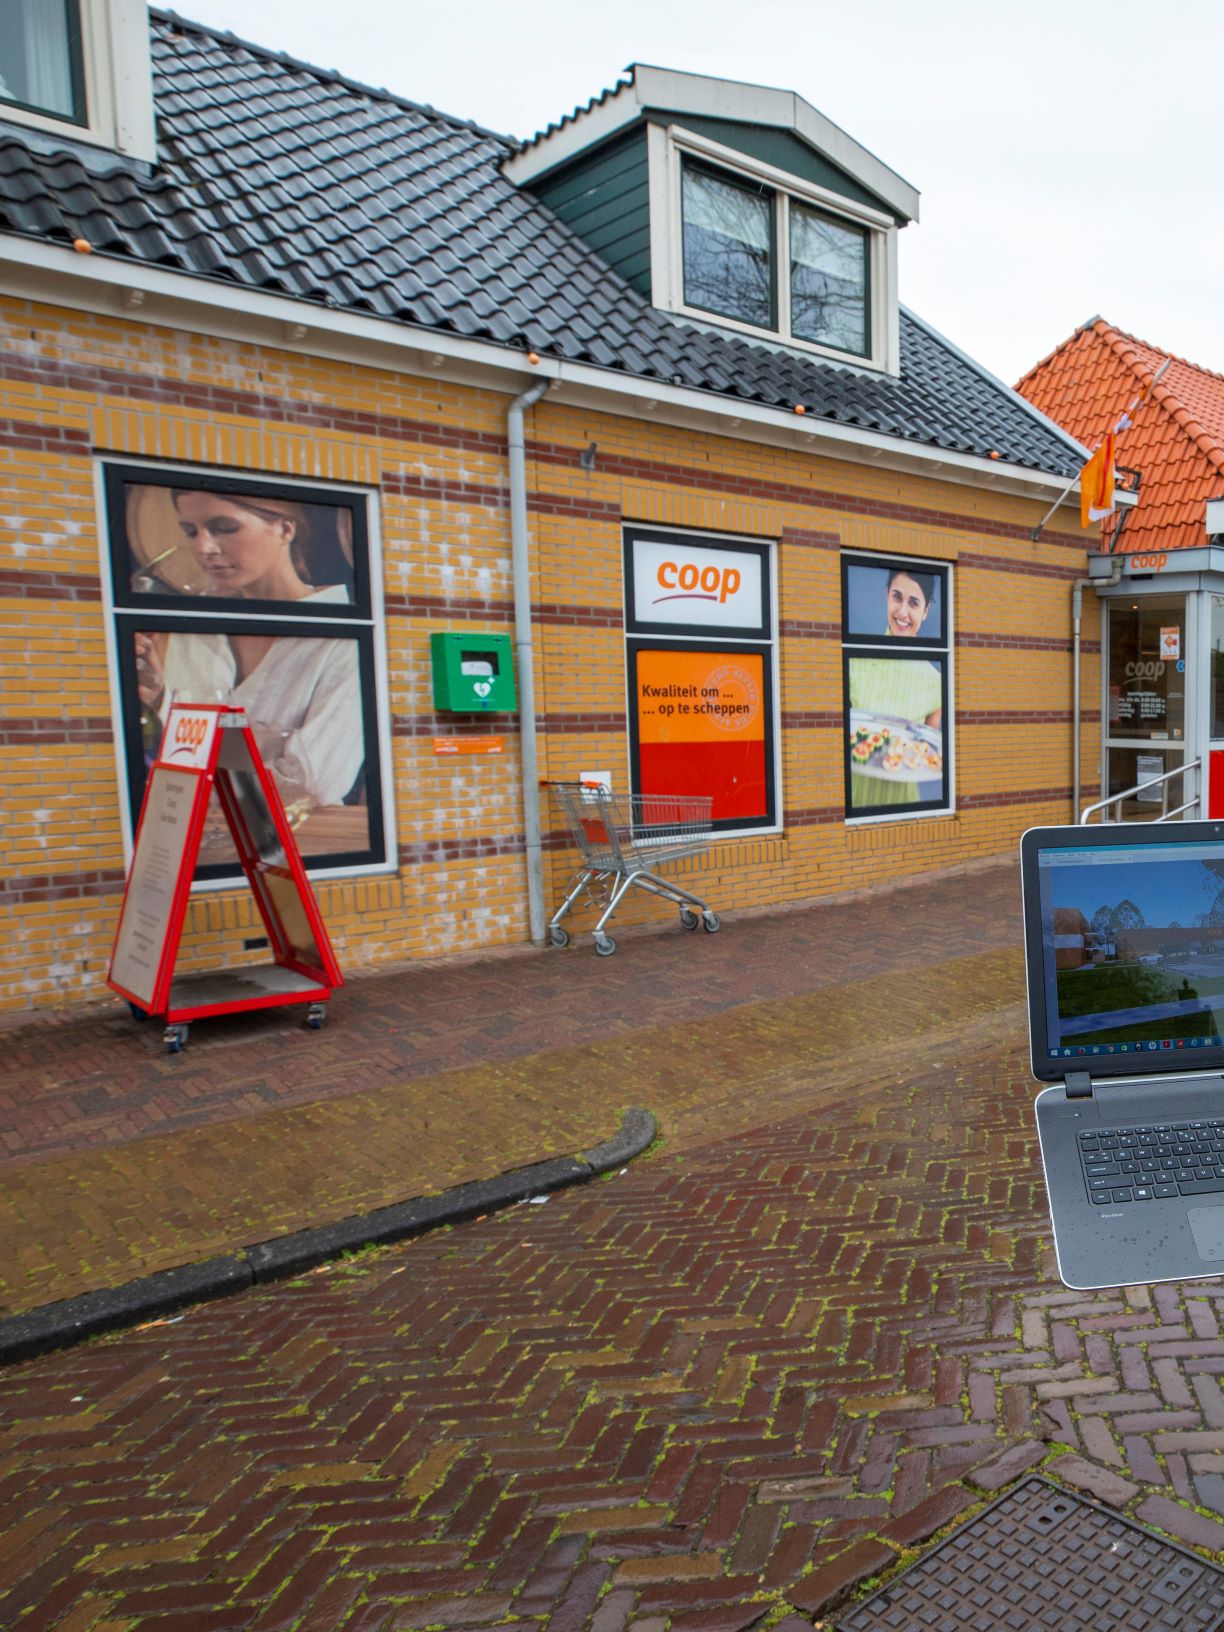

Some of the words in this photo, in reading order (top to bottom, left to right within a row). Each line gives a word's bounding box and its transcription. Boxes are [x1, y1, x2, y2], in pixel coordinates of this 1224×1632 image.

[1131, 554, 1168, 573] coop
[657, 561, 741, 603] coop
[1125, 661, 1165, 682] coop
[641, 684, 698, 698] Kwaliteit
[701, 688, 719, 698] om
[658, 703, 675, 717] op
[678, 702, 690, 714] te
[693, 701, 750, 717] scheppen
[175, 717, 207, 755] coop
